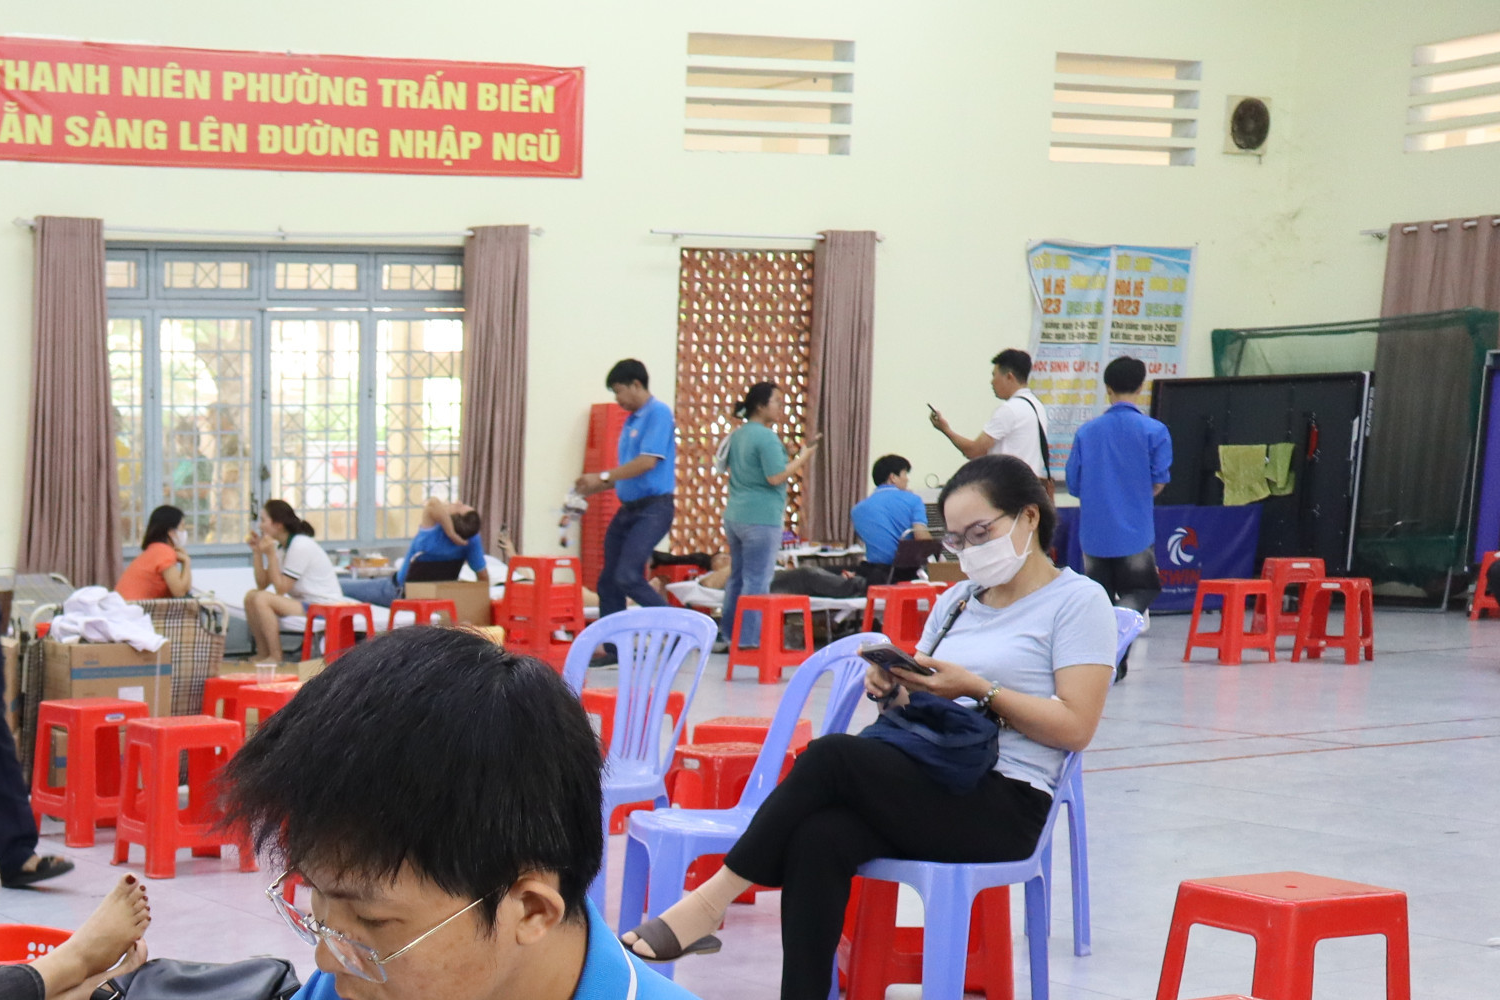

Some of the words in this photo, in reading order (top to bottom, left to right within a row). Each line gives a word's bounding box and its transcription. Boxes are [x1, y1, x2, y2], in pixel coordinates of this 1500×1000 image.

[121, 61, 211, 100] NIÊN
[222, 67, 368, 107] PHƯỜNG
[378, 70, 467, 110] TRẤN
[477, 77, 555, 113] BIÊN
[64, 110, 168, 150] SÀNG
[179, 115, 247, 153] LÊN
[257, 119, 379, 157] ĐƯỜNG
[389, 124, 482, 166] NHẬP
[492, 128, 561, 163] NGŨ
